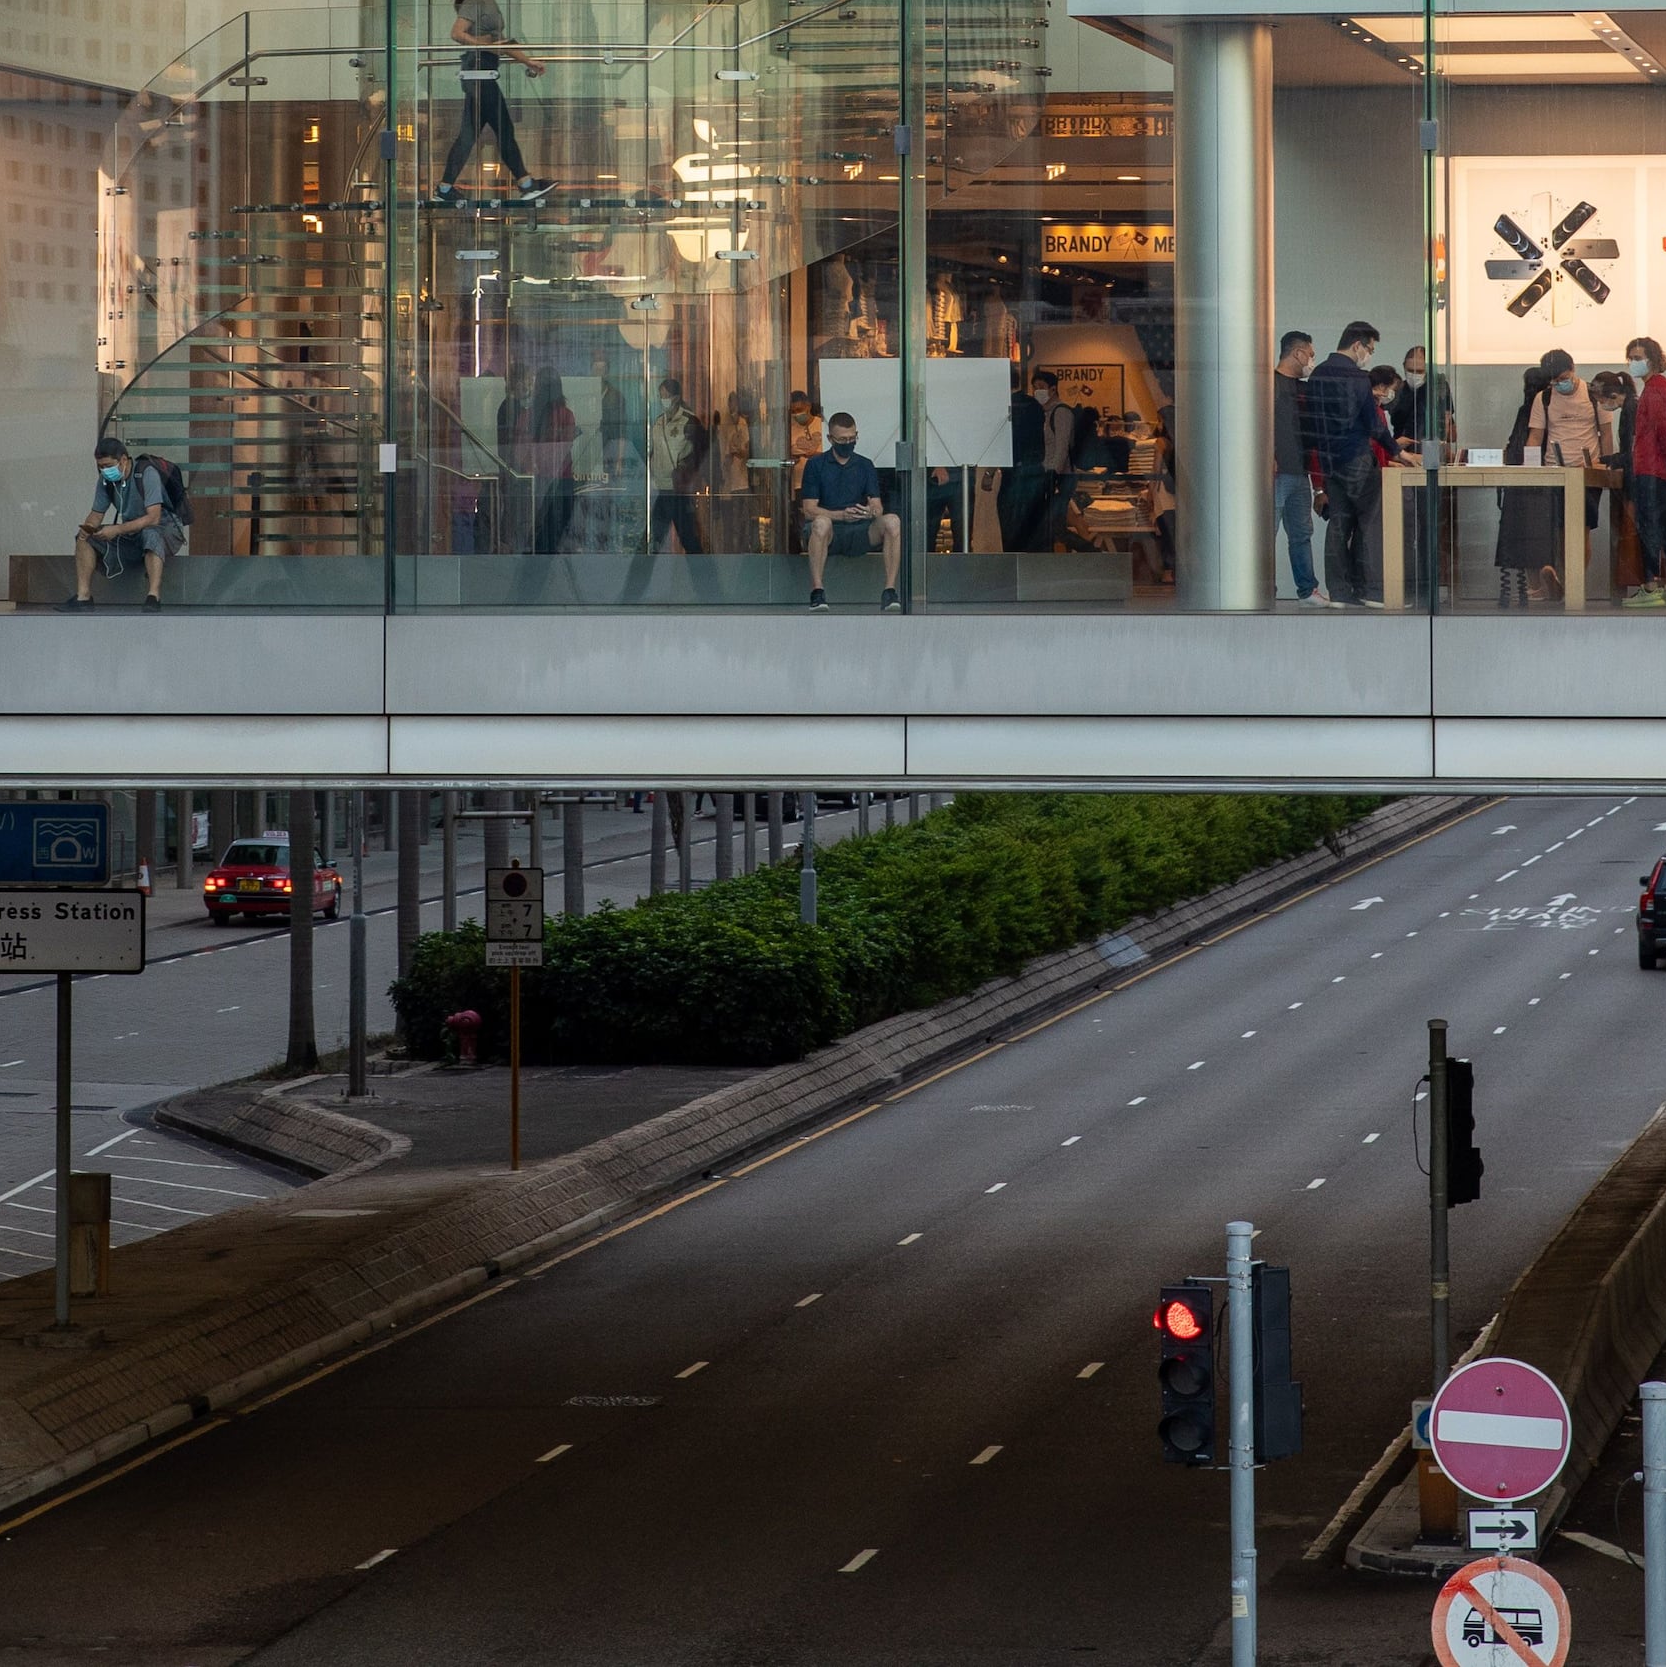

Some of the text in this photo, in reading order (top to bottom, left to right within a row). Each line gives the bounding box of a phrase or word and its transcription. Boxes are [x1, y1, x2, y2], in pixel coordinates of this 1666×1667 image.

[1046, 236, 1112, 253] BRANDY
[1056, 368, 1104, 382] BRANDY
[83, 848, 95, 859] W
[54, 902, 135, 921] Station
